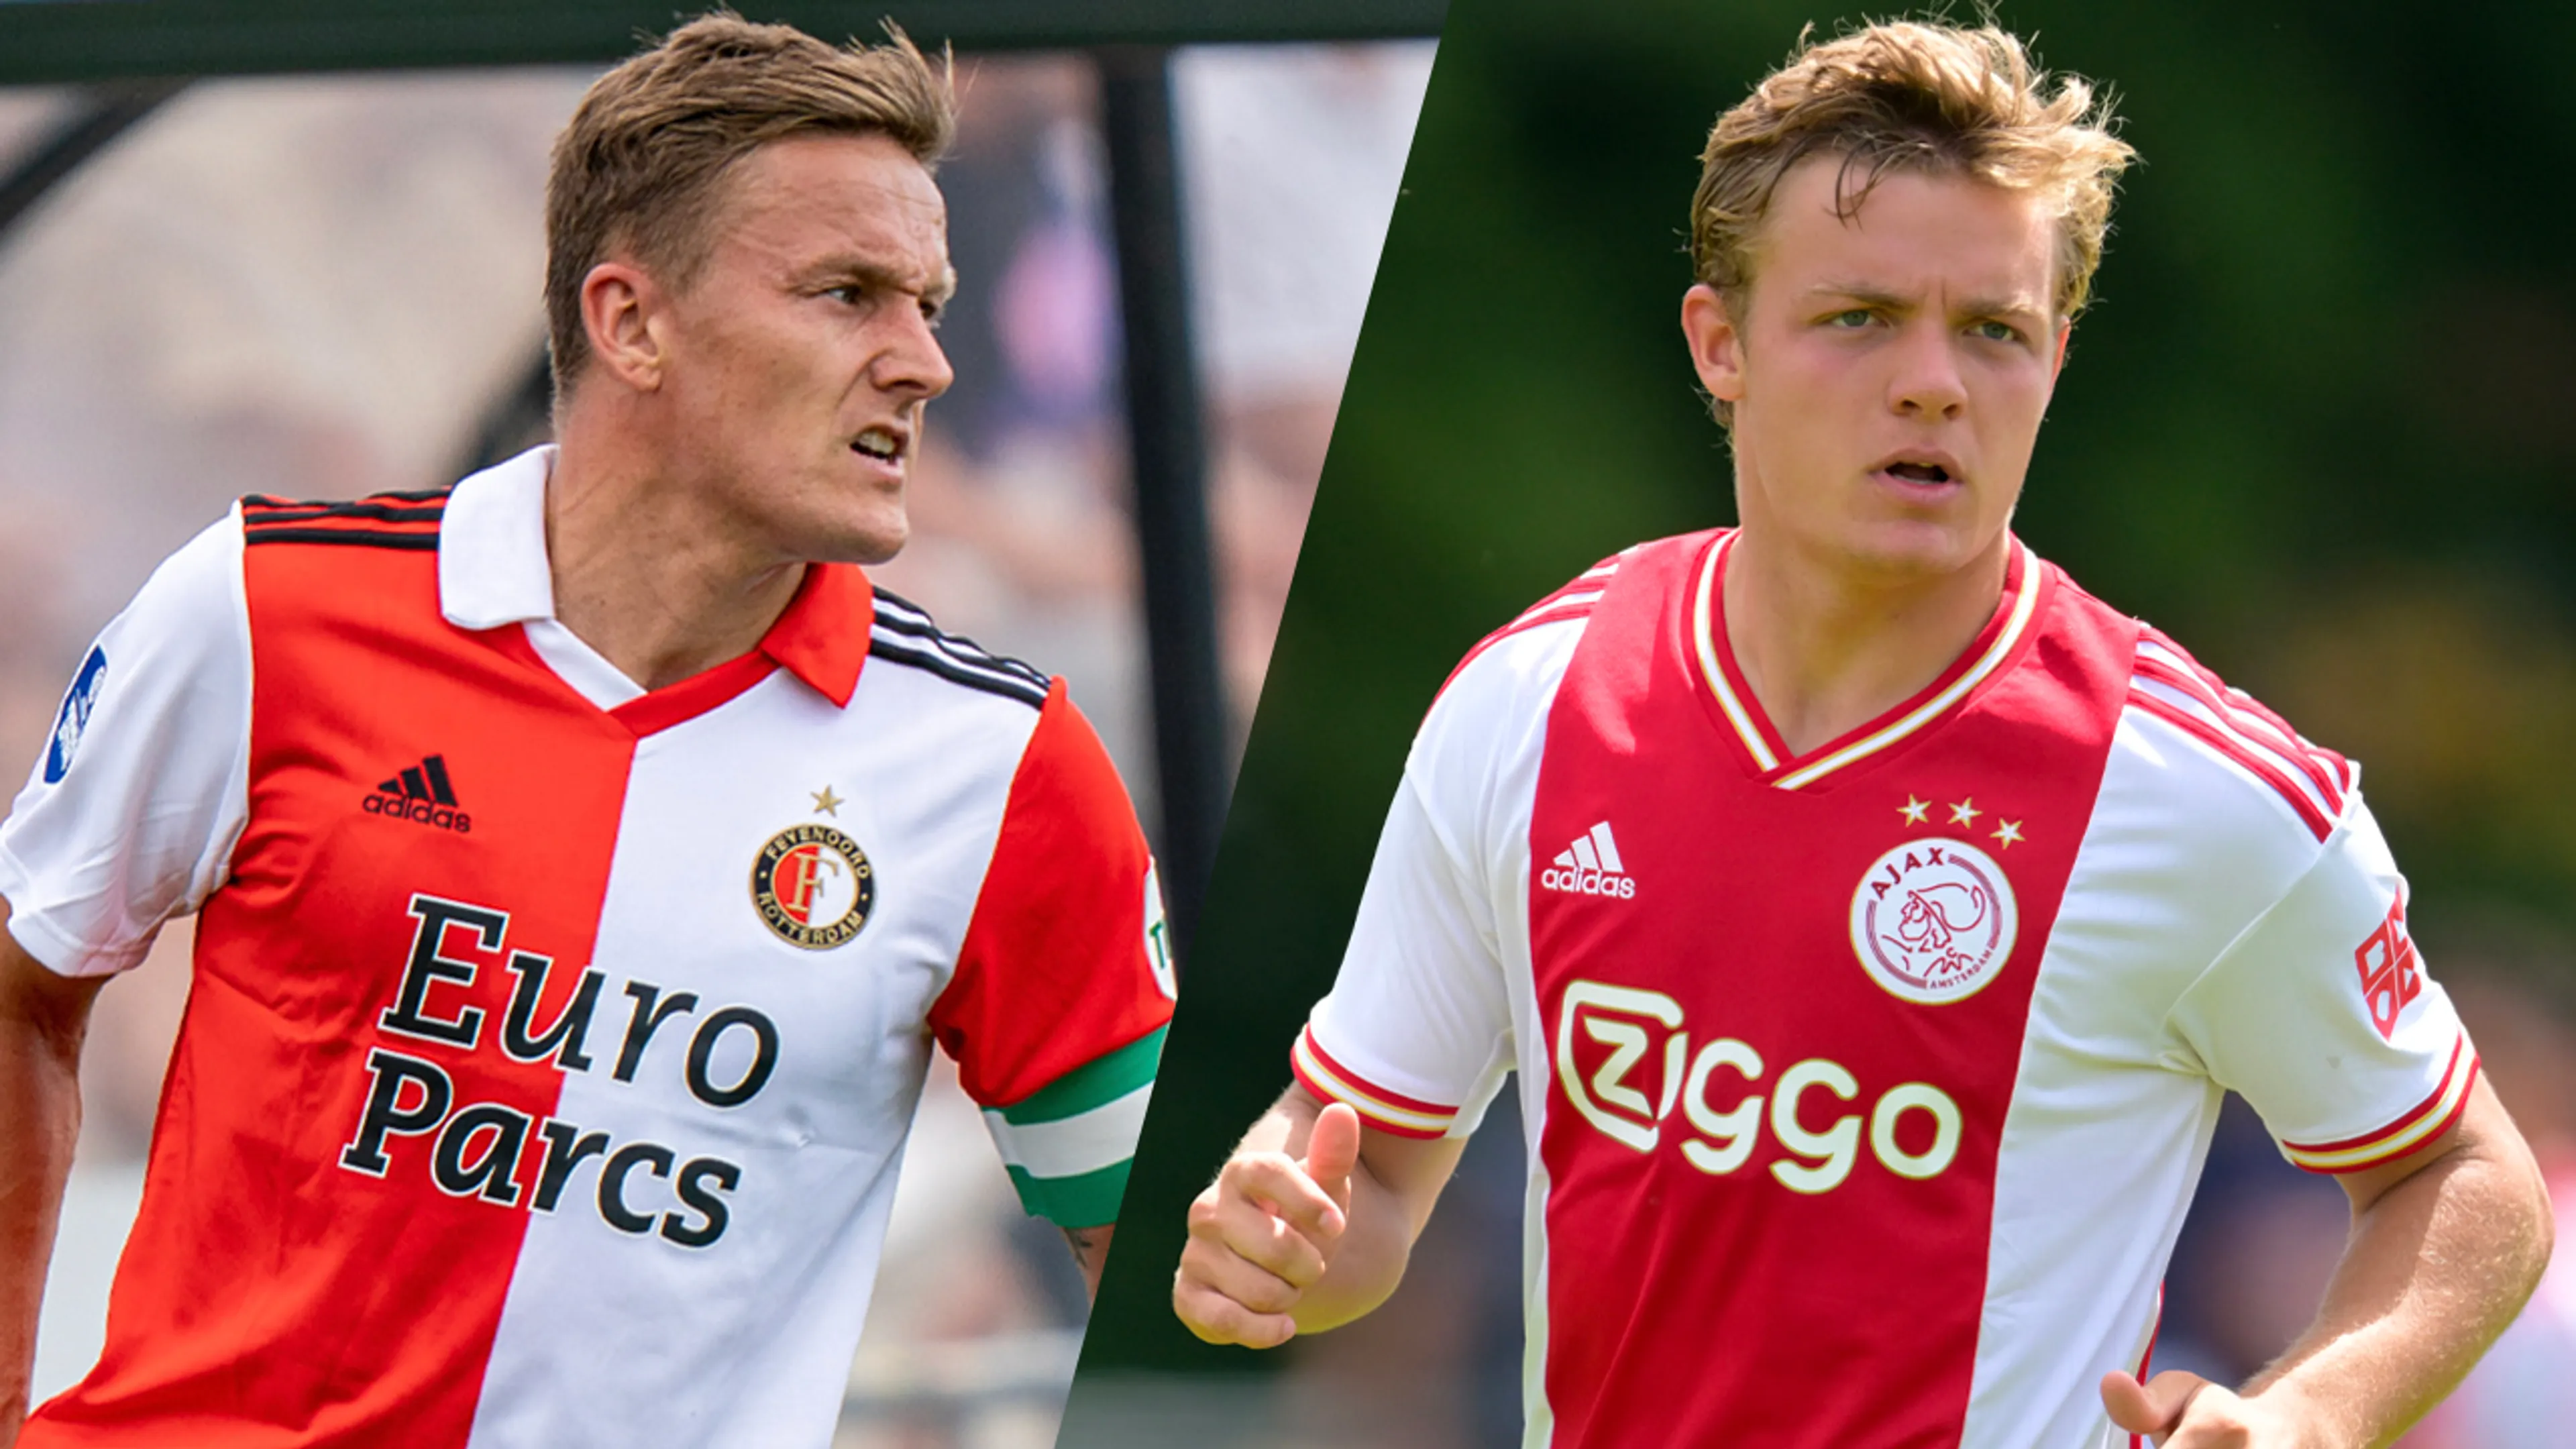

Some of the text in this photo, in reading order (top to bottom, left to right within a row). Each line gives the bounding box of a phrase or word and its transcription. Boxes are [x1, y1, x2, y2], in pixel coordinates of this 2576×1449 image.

[362, 793, 472, 833] adidas
[765, 825, 871, 879] FEYENOORD
[1870, 847, 1944, 901] AJAX
[786, 851, 840, 913] F
[1541, 864, 1637, 900] adidas
[758, 891, 863, 946] ROTTERDAM
[1930, 949, 1994, 989] AMSTERDAM
[377, 893, 782, 1109] Euro
[1557, 979, 1964, 1195] Ziggo
[337, 1046, 743, 1249] Parcs
